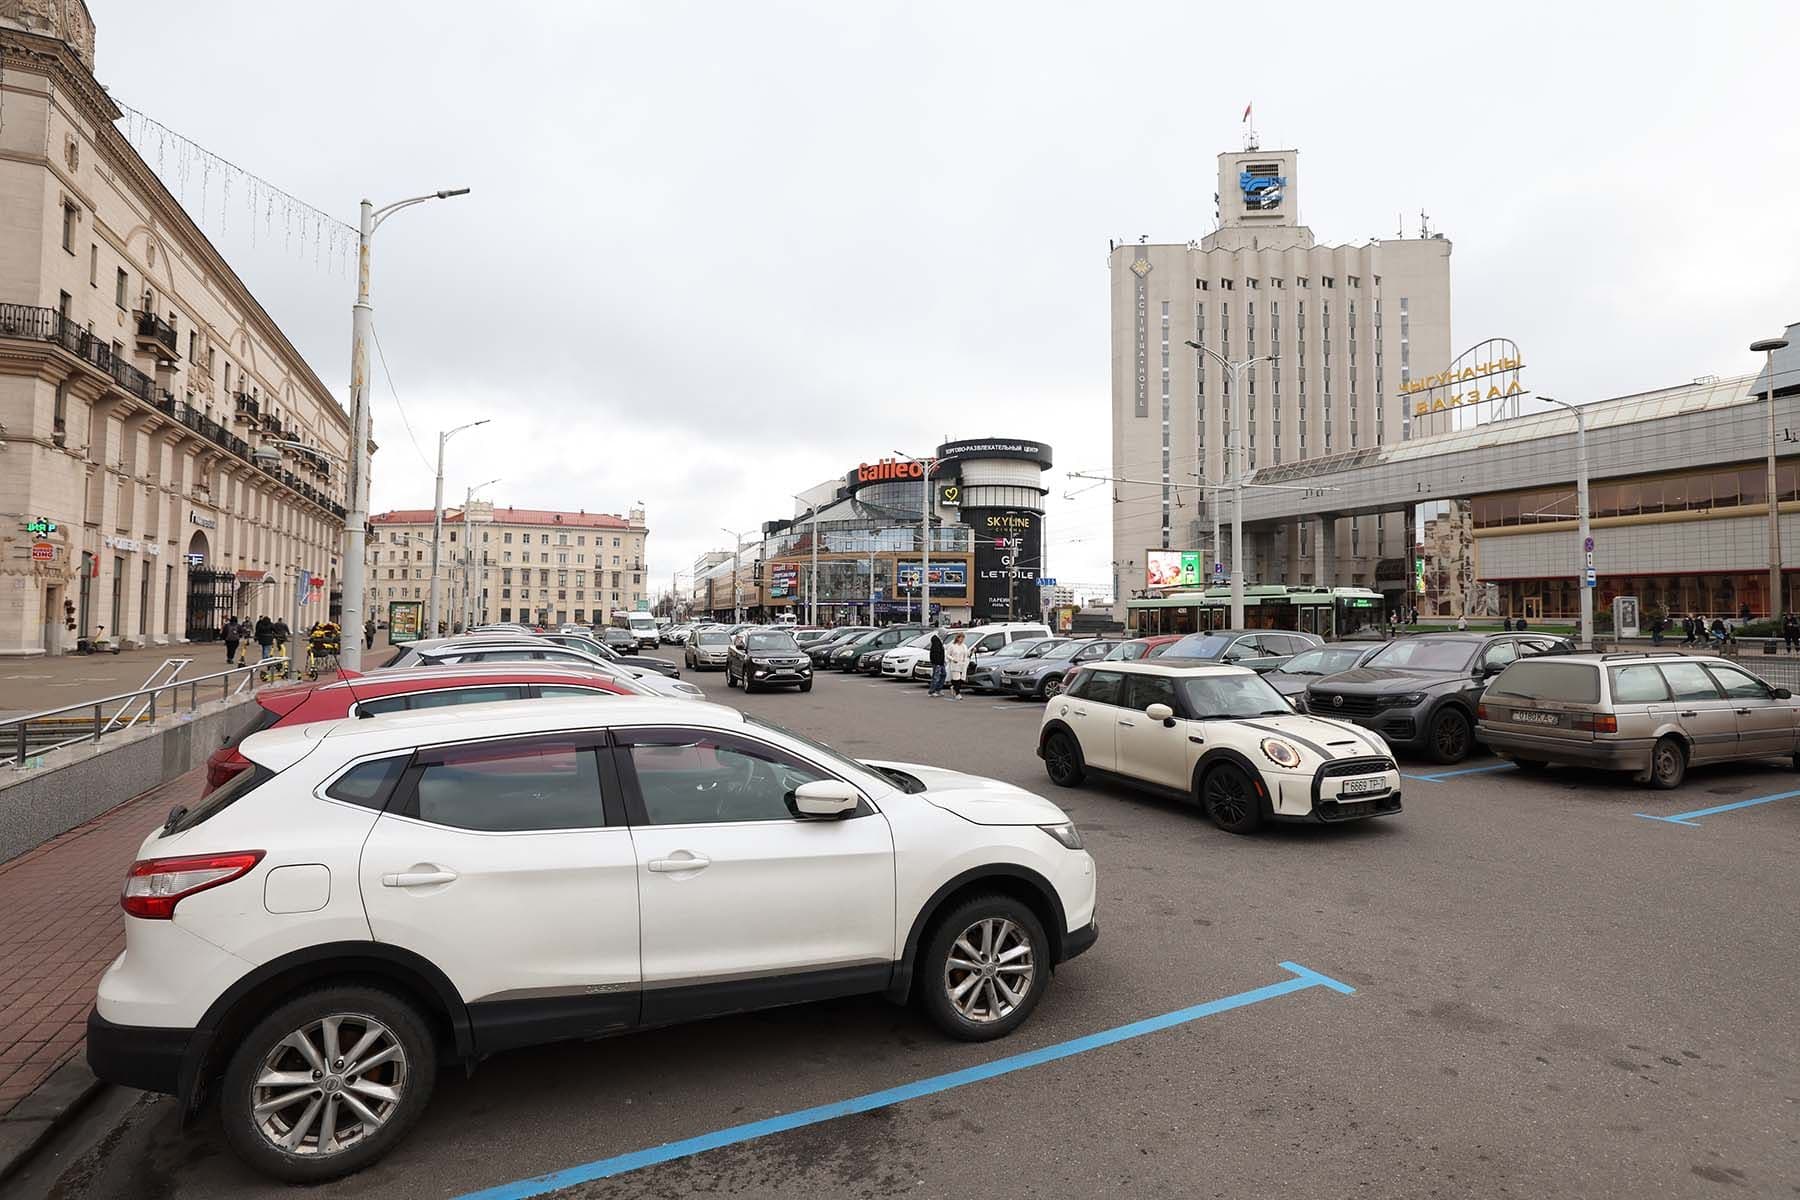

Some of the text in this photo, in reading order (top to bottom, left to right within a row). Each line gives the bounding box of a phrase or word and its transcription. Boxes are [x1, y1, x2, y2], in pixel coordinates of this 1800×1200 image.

[1138, 367, 1146, 407] HOTEL
[1399, 353, 1520, 393] ЧЫГУНАЧНЫ
[1415, 379, 1522, 414] ВАКЗАЛ
[858, 458, 924, 481] Galileo
[987, 516, 1030, 528] SKYLINE
